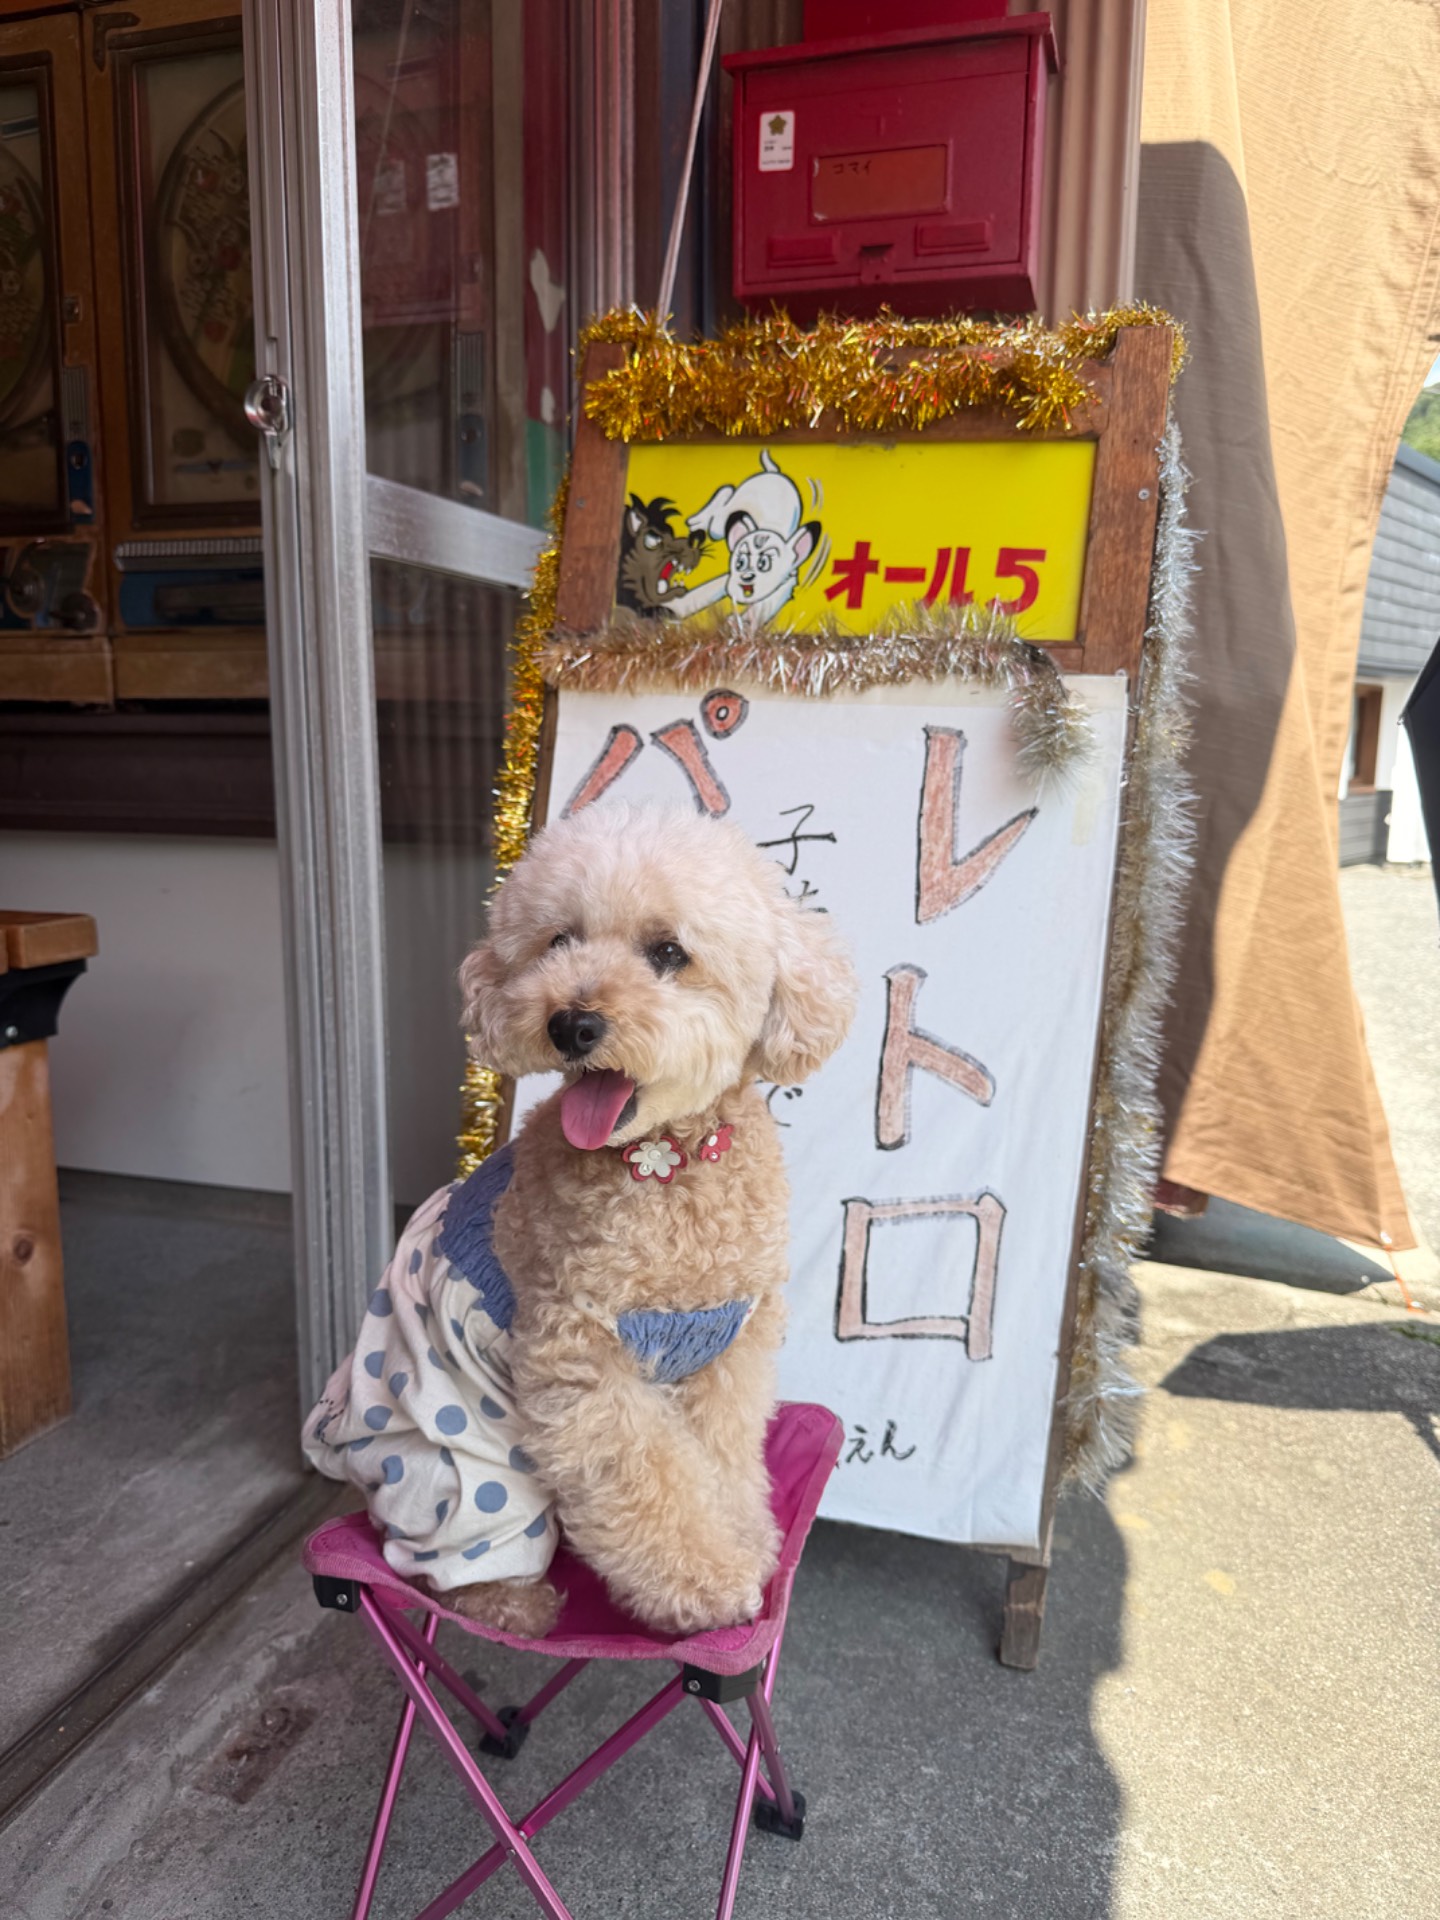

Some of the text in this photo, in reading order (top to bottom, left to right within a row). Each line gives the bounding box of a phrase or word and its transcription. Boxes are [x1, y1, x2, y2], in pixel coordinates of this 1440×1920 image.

[824, 541, 1047, 615] オール5
[756, 803, 838, 914] 子
[834, 724, 1039, 1361] レトロ
[835, 1419, 917, 1469] えん
